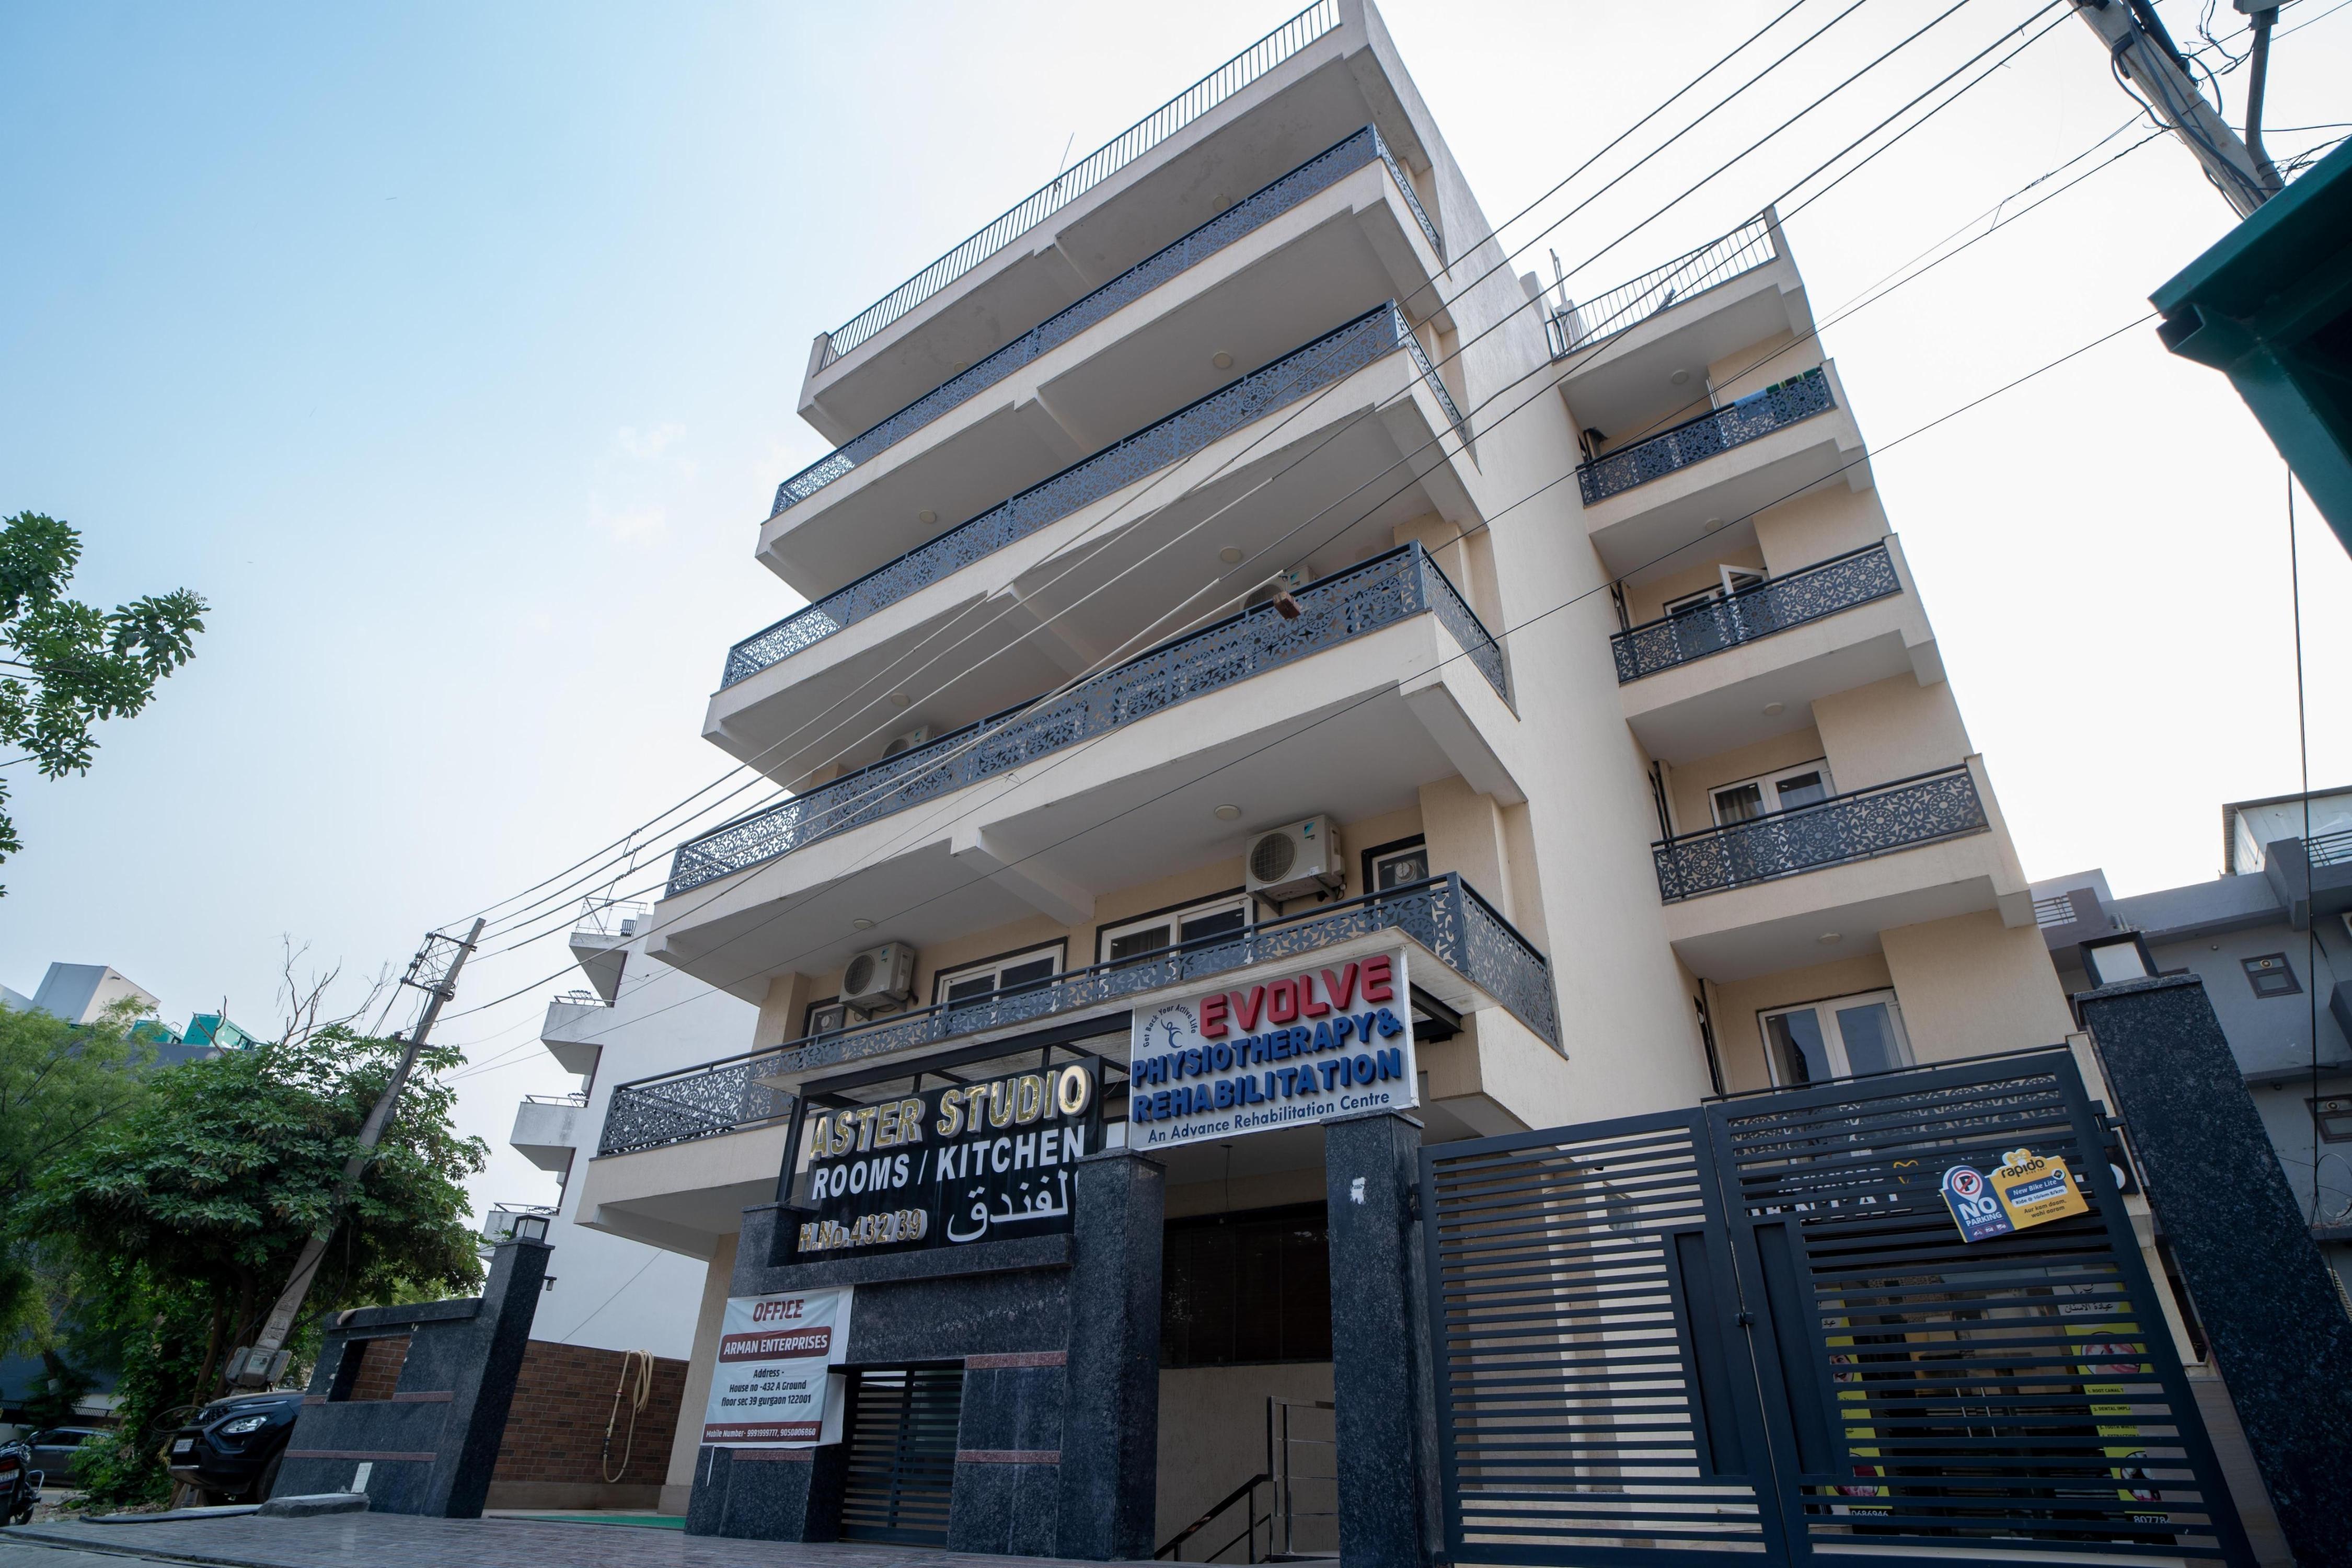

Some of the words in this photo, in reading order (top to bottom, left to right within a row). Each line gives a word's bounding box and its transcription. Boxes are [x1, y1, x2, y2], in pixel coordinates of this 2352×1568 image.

[1200, 954, 1393, 1039] EVOLVE
[1145, 1014, 1159, 1032] Back
[1158, 1006, 1174, 1016] Your
[1175, 1004, 1193, 1020] Active
[1190, 1018, 1198, 1034] Life
[1132, 1047, 1401, 1123] REHABILITATION
[808, 1098, 926, 1162] ASTER
[937, 1065, 1091, 1138] STUDIO
[1148, 1129, 1166, 1144] An
[1170, 1120, 1229, 1140] Advance
[1235, 1100, 1335, 1128] Rehabilitation
[1341, 1092, 1390, 1110] Centre
[811, 1154, 910, 1200] ROOMS
[936, 1124, 1085, 1181] KITCHEN
[2001, 1159, 2045, 1178] rapido
[2013, 1187, 2027, 1196] New
[2028, 1182, 2043, 1192] Bike
[1958, 1196, 1997, 1220] NO
[2046, 1206, 2065, 1214] aaram
[1966, 1212, 2003, 1227] PARKING
[753, 1299, 804, 1322] OFFICE
[723, 1340, 759, 1355] ARMAN
[760, 1334, 828, 1353] ENTERPRISES
[753, 1369, 780, 1378] Address
[729, 1384, 751, 1392] House
[776, 1382, 780, 1391] A
[782, 1380, 807, 1390] Ground
[721, 1397, 736, 1406] floor
[749, 1397, 757, 1405] 39
[758, 1396, 787, 1406] gurgaon
[788, 1394, 811, 1404] 122001
